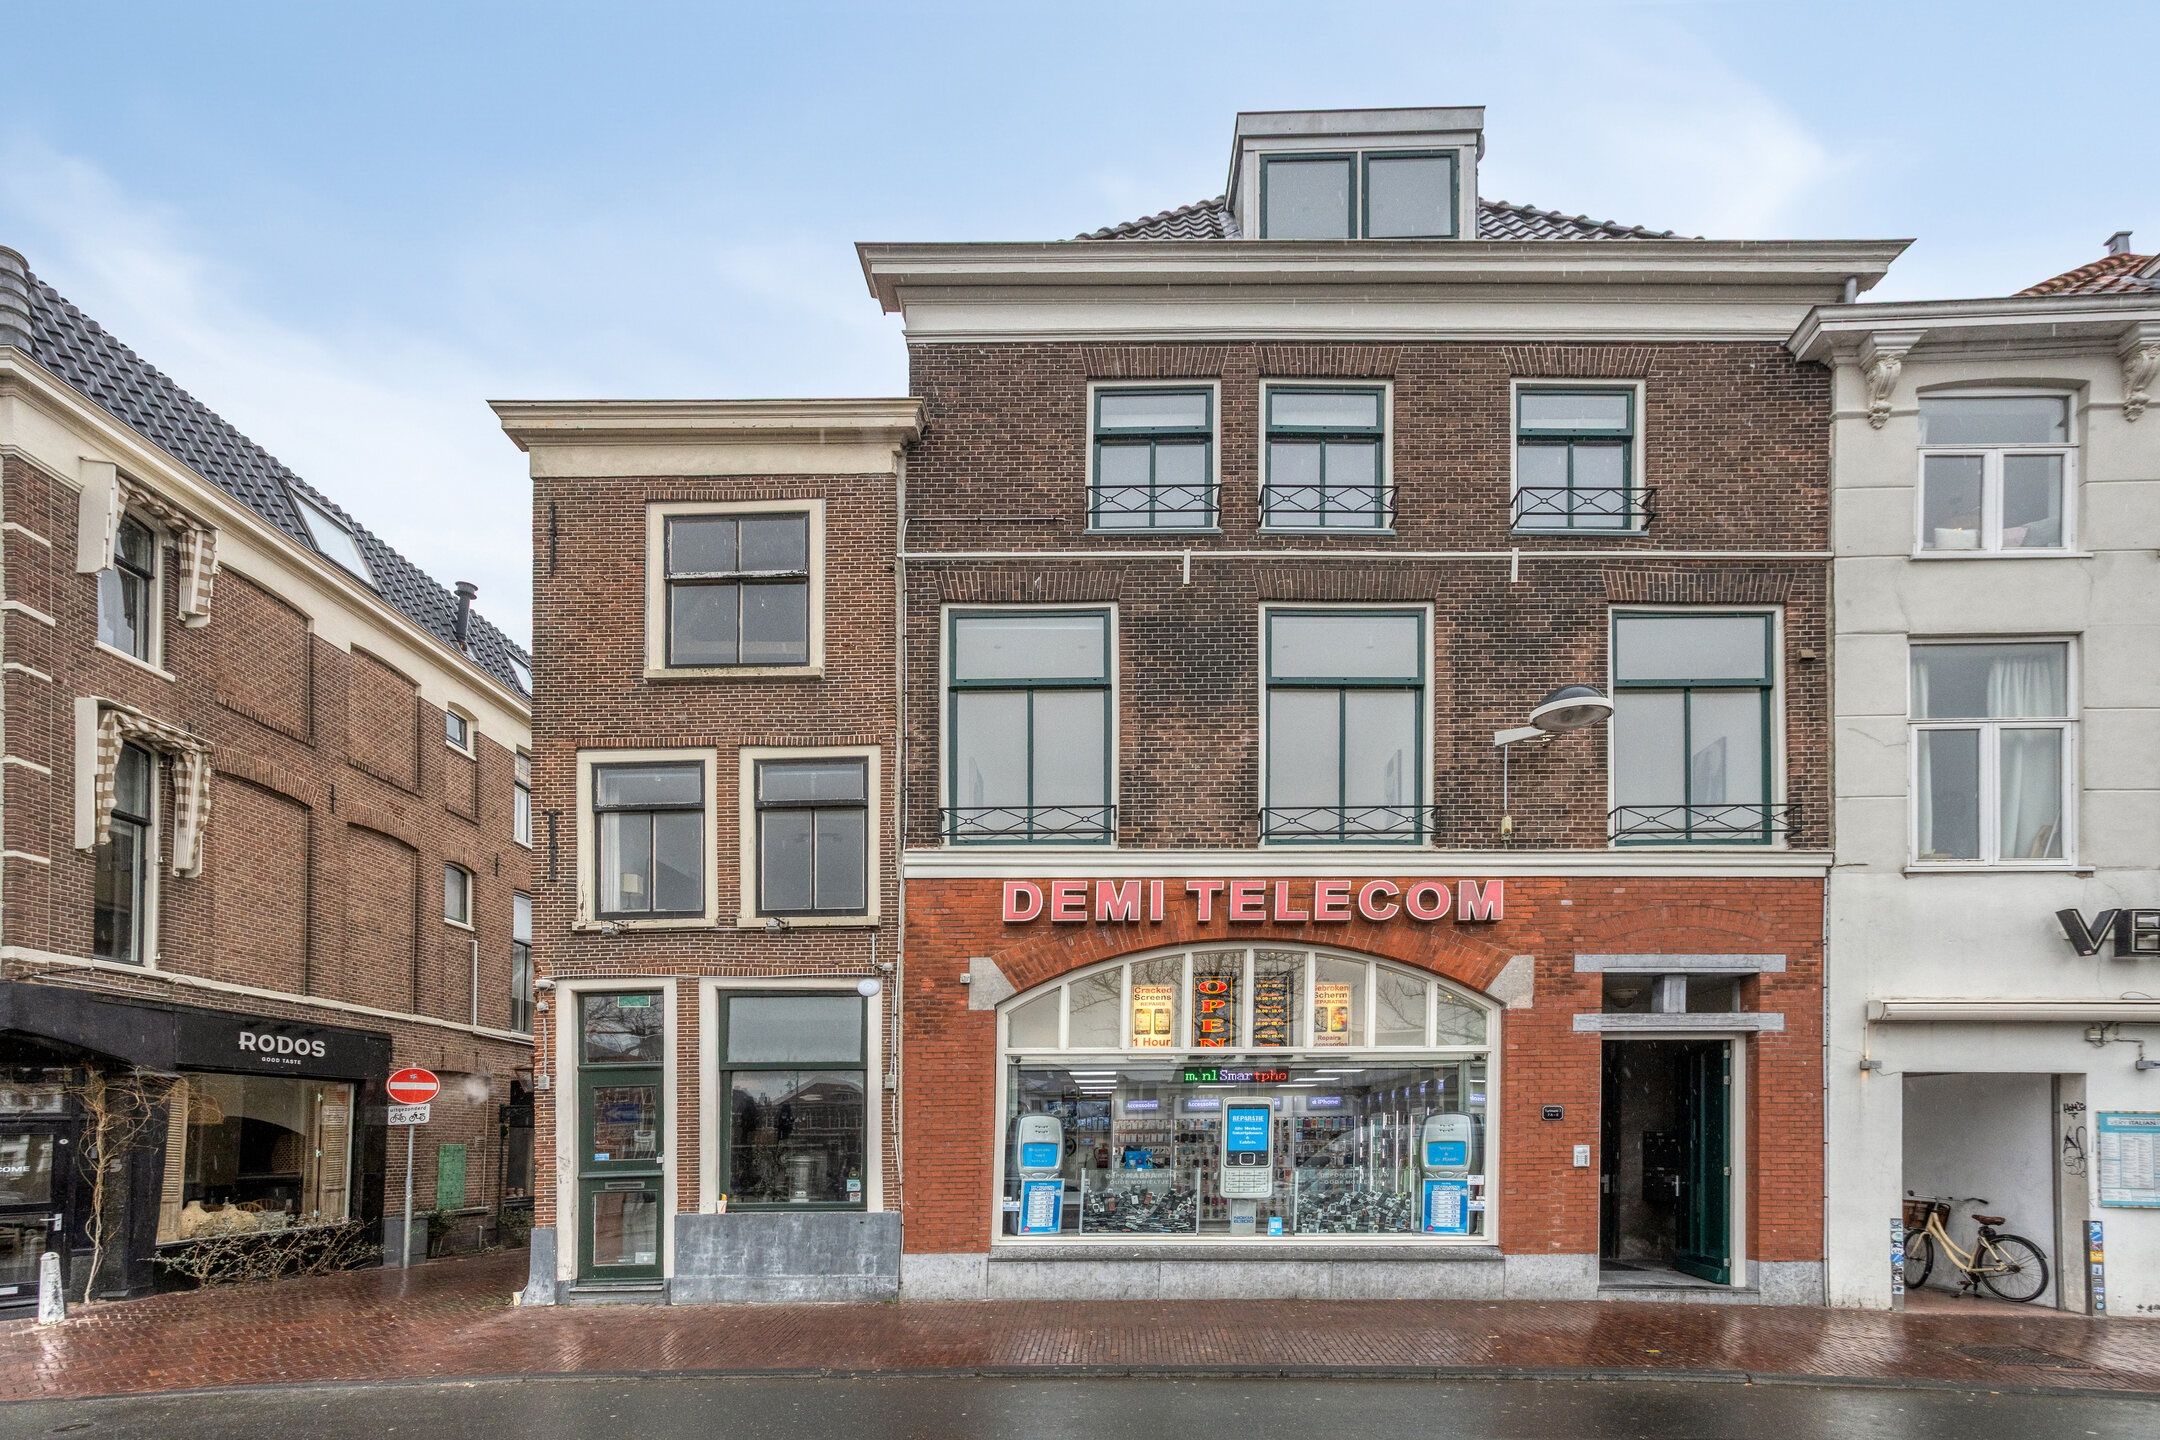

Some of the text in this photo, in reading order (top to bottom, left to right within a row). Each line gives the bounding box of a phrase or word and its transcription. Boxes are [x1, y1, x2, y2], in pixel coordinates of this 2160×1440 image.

[1002, 879, 1504, 922] DEMI TELECOM
[1134, 986, 1172, 994] Cracked
[1198, 980, 1228, 1047] OPEN
[238, 1031, 326, 1058] RODOS
[1132, 1037, 1171, 1047] 1 Hour
